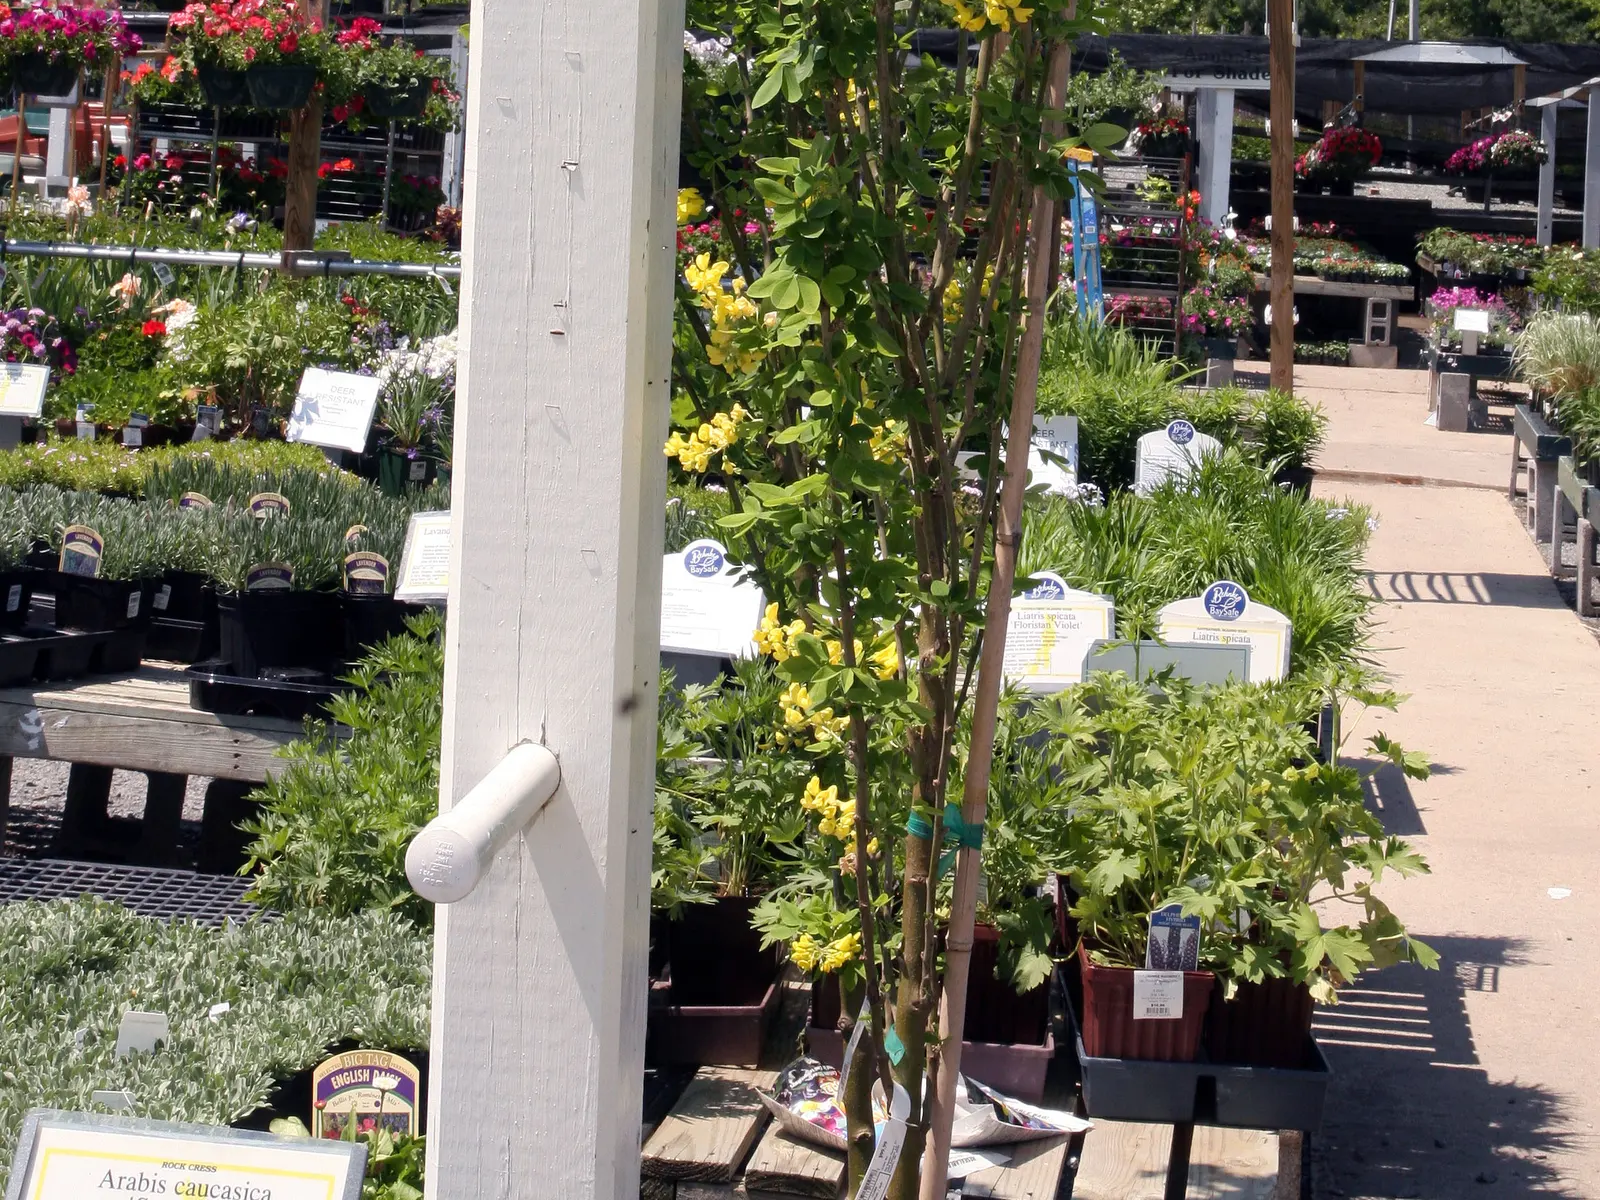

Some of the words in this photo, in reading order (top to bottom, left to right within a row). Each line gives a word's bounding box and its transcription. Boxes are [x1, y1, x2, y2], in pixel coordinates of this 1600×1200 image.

[330, 385, 356, 396] DEER
[1017, 611, 1045, 621] Liatris
[1047, 612, 1076, 623] spicata
[1210, 606, 1240, 617] BaySafe
[1055, 621, 1083, 630] Violet'
[1192, 631, 1219, 641] Liatris
[1222, 632, 1251, 644] spicata
[343, 1053, 363, 1069] BIG
[365, 1053, 389, 1067] TAG
[330, 1069, 370, 1090] ENGLISH
[162, 1161, 187, 1170] ROCK
[188, 1163, 218, 1173] CRESS
[97, 1169, 167, 1194] Arabis
[174, 1180, 273, 1200] caucasica
